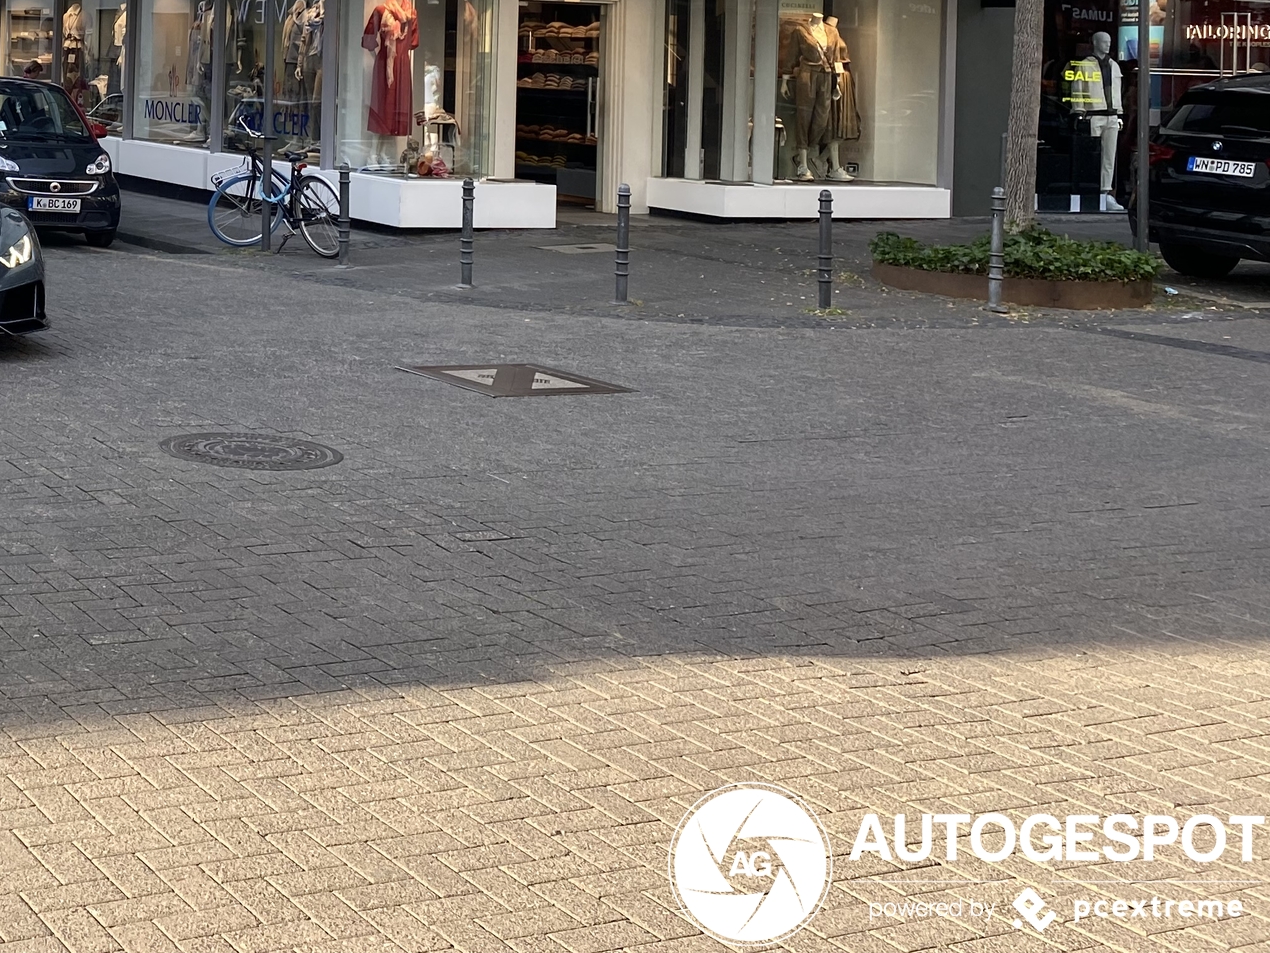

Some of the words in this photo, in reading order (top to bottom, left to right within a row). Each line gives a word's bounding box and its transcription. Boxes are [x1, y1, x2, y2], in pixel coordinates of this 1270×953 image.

[1064, 70, 1101, 82] SALE
[144, 99, 203, 125] MONCLER
[1194, 159, 1209, 170] WN
[1215, 161, 1230, 172] PD
[1232, 163, 1253, 175] 785
[36, 198, 44, 207] K
[48, 199, 60, 208] BC
[61, 200, 77, 209] 169
